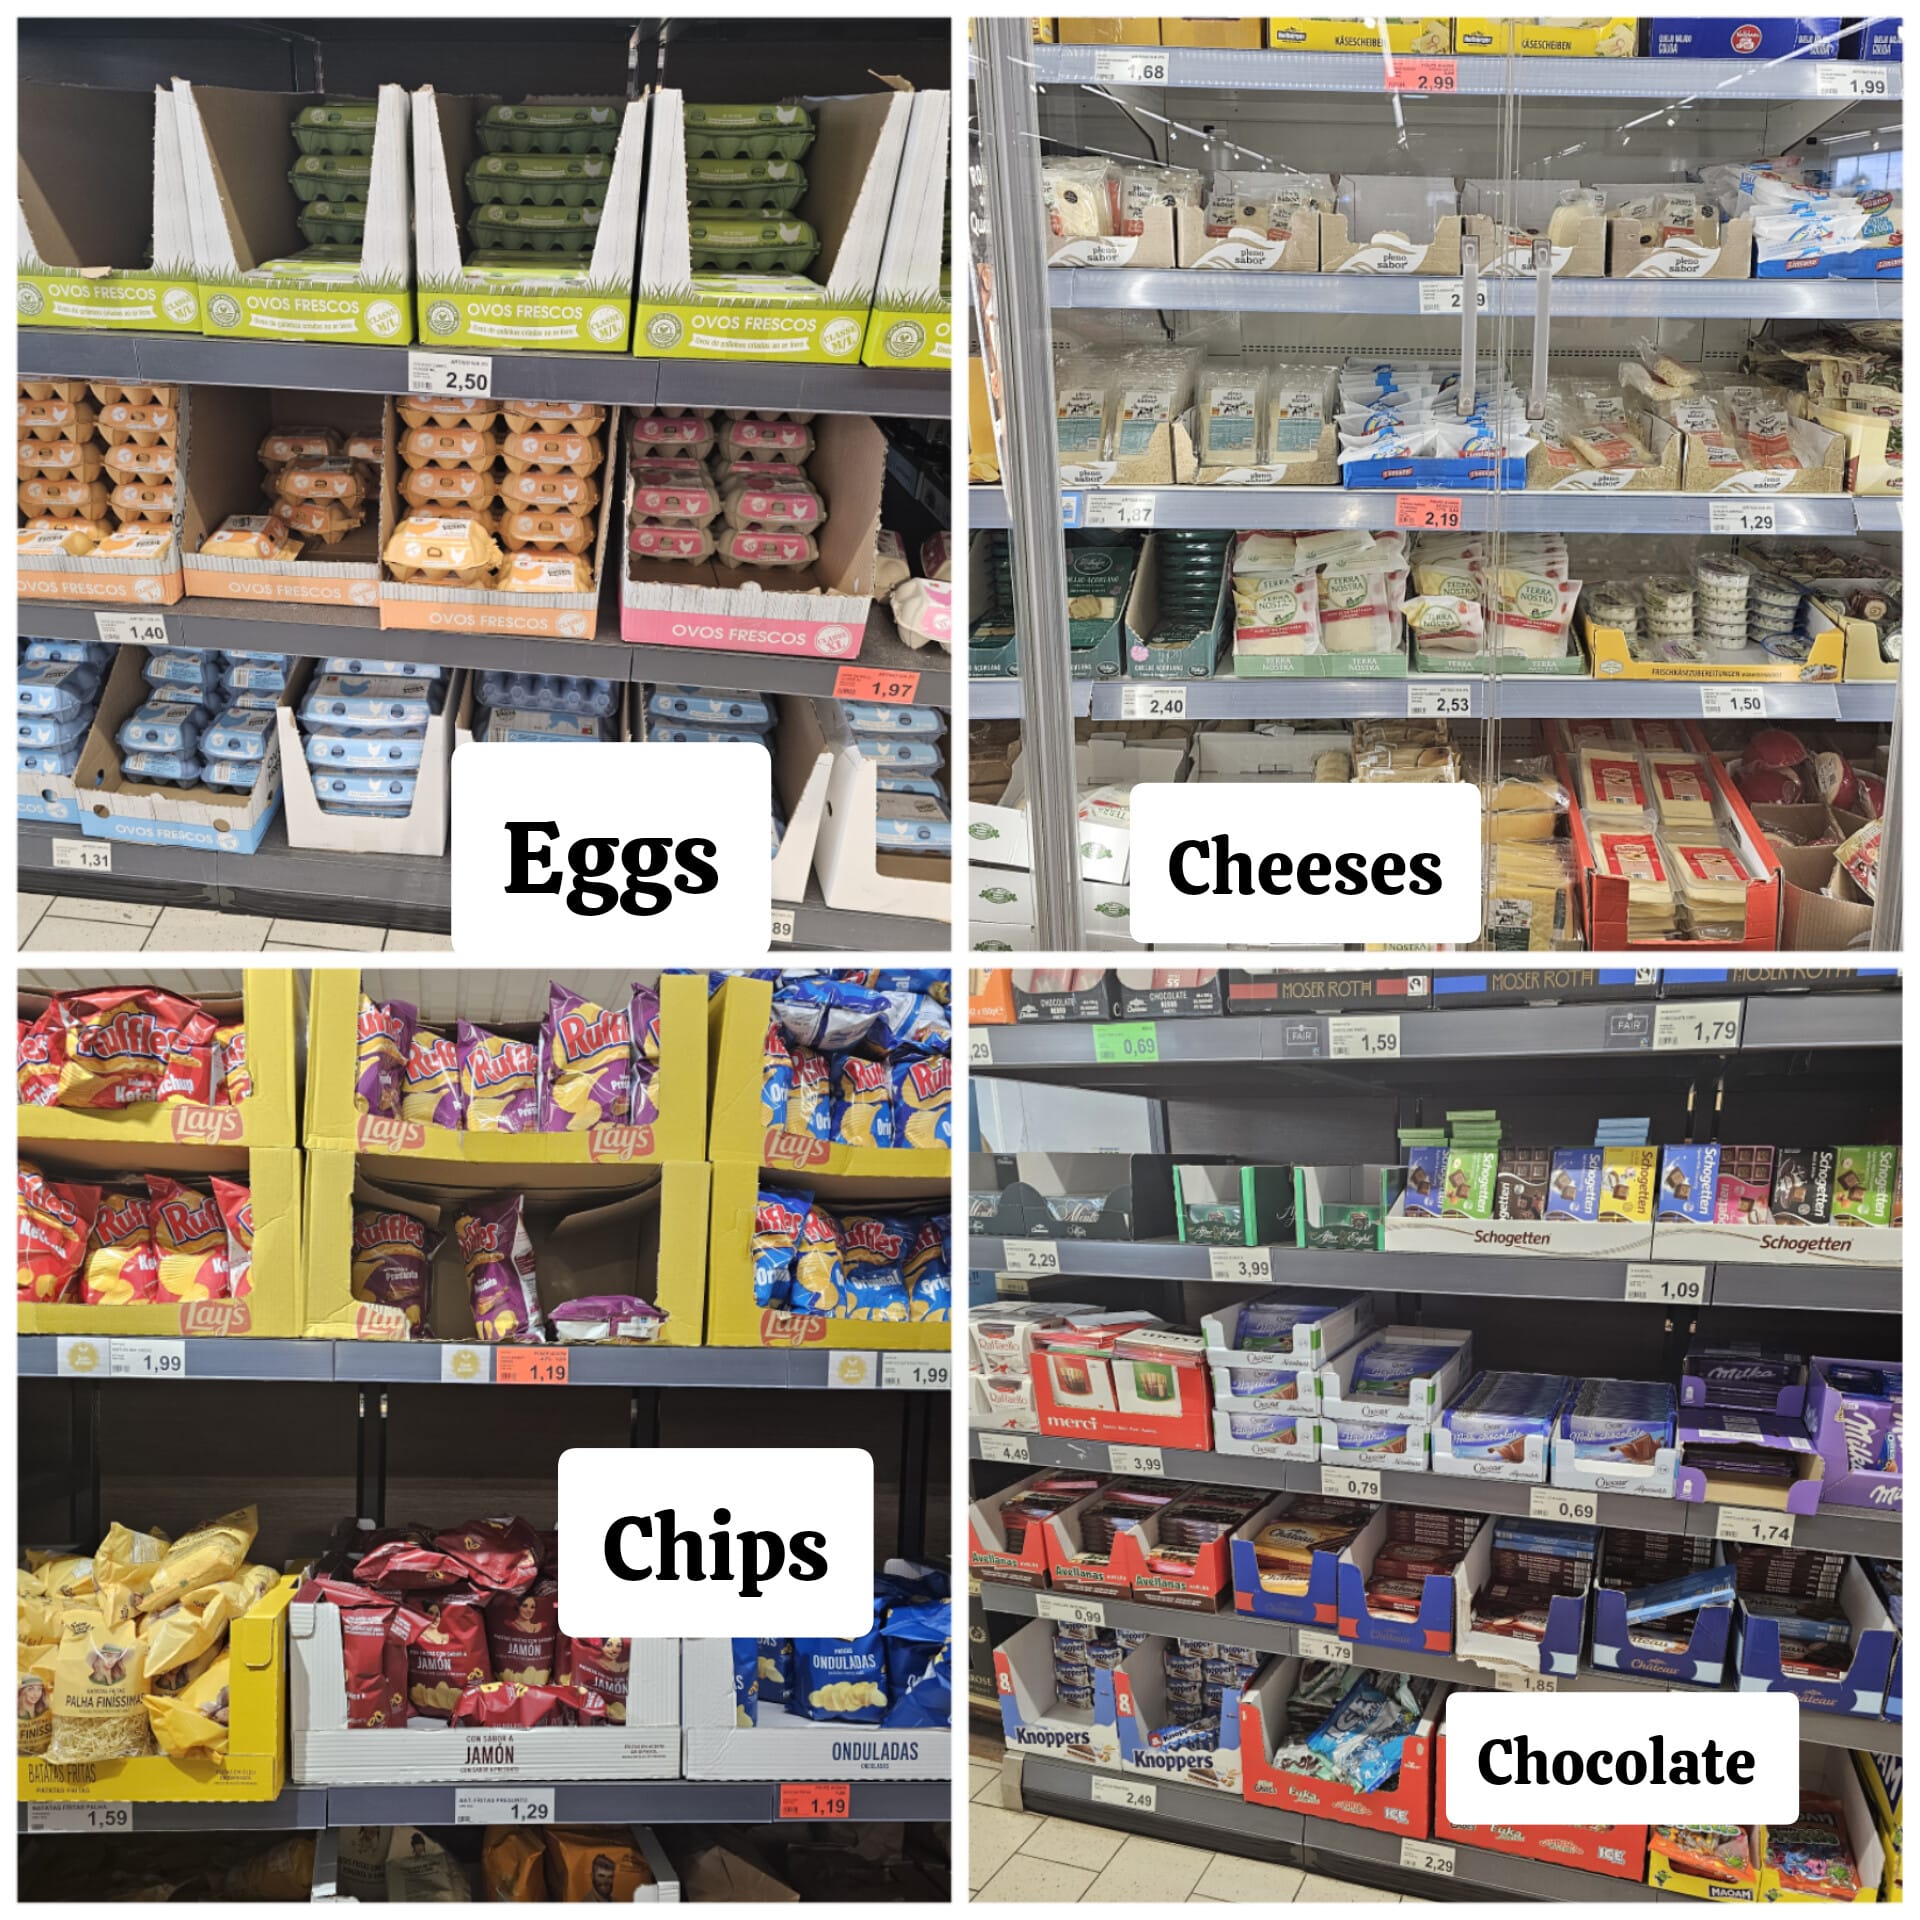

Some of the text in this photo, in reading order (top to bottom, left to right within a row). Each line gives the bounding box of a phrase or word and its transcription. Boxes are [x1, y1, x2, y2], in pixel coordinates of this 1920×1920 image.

[1128, 64, 1164, 80] 1,68
[1418, 76, 1454, 90] 2,99
[1850, 79, 1885, 94] 1,99
[1087, 252, 1118, 262] sabor
[1092, 246, 1117, 255] pleno
[1240, 250, 1264, 258] pleno
[1383, 253, 1407, 262] pleno
[1234, 254, 1266, 264] sabor
[1377, 260, 1408, 270] sabor
[1676, 257, 1700, 266] pleno
[1668, 262, 1700, 273] sabor
[48, 284, 156, 300] OVOS FRESCOS
[246, 296, 360, 314] OVOS FRESCOS
[467, 303, 583, 320] OVOS FRESCOS
[691, 315, 816, 332] OVOS FRESCOS
[446, 372, 488, 390] 2,50
[1118, 508, 1152, 522] 1,87
[1425, 512, 1458, 526] 2,19
[1740, 515, 1773, 530] 1,29
[17, 580, 128, 596] OVOS FRESCOS
[1330, 583, 1364, 592] NOSTRA
[1335, 577, 1361, 585] TERRA
[1446, 582, 1472, 590] TERRA
[228, 582, 342, 599] OVOS FRESCOS
[1443, 587, 1476, 595] NOSTRA
[1526, 588, 1551, 597] TERRA
[1520, 594, 1556, 604] NOSTRA
[430, 612, 548, 630] OVOS FRESCOS
[1423, 620, 1458, 628] NOSTRA
[130, 626, 164, 641] 1,40
[672, 624, 806, 646] OVOS FRESCOS
[1263, 664, 1294, 672] NOSTRA
[1266, 658, 1292, 666] TERRA
[1348, 664, 1380, 672] NOSTRA
[1352, 658, 1377, 666] TERRA
[1448, 660, 1472, 668] TERRA
[872, 682, 912, 698] 1,97
[1150, 700, 1183, 714] 2,40
[1436, 698, 1469, 712] 2,53
[1730, 696, 1760, 712] 1,50
[115, 824, 214, 845] OVOS FRESCOS
[80, 853, 110, 867] 1,31
[1492, 970, 1594, 992] MOSER ROTH
[1733, 969, 1788, 982] MOSER
[1150, 991, 1188, 1001] CHOCOLATE
[1283, 980, 1372, 998] MOSER ROTH
[1040, 998, 1074, 1007] CHOCOLATE
[1618, 1020, 1642, 1031] FAIR
[1694, 1022, 1736, 1042] 1,79
[1292, 1032, 1312, 1040] FAIR
[1361, 1034, 1396, 1052] 1,59
[1124, 1038, 1156, 1054] 0,69
[1477, 1152, 1494, 1213] Schogetten
[1584, 1153, 1600, 1215] Schogetten
[1637, 1152, 1653, 1214] Schogetten
[1700, 1147, 1718, 1215] Schogetten
[1814, 1151, 1832, 1217] Schogetten
[1874, 1152, 1892, 1218] Schogetten
[1474, 1230, 1550, 1247] Schogetten
[1760, 1234, 1852, 1253] Schogetten
[1029, 1252, 1057, 1268] 2,29
[1238, 1260, 1270, 1277] 3,99
[1660, 1282, 1700, 1299] 1,09
[978, 1338, 1020, 1352] Raffaello
[144, 1356, 181, 1374] 1,99
[530, 1365, 566, 1381] 1,19
[1708, 1366, 1776, 1380] Milka
[913, 1368, 948, 1384] 1,99
[1047, 1416, 1098, 1432] merci
[1003, 1448, 1028, 1461] 4,49
[1134, 1458, 1161, 1473] 3,99
[1348, 1480, 1378, 1495] 0,79
[1559, 1502, 1594, 1518] 0,69
[1752, 1524, 1790, 1541] 1,74
[972, 1552, 1017, 1567] Avellanas
[1055, 1564, 1104, 1581] Avellanas
[1135, 1575, 1186, 1591] Avellanas
[1074, 1609, 1101, 1623] 0,99
[508, 1642, 542, 1657] JAMÓN
[1322, 1646, 1351, 1660] 1,79
[417, 1654, 452, 1671] JAMÓN
[812, 1654, 876, 1670] ONDULADAS
[1632, 1658, 1680, 1675] Château
[594, 1676, 629, 1696] JAMÓN
[1524, 1678, 1554, 1692] 1,85
[66, 1695, 94, 1707] PALHA
[1015, 1727, 1090, 1746] Knoppers
[464, 1743, 514, 1765] JAMÓN
[832, 1742, 918, 1761] ONDULADAS
[1134, 1749, 1214, 1771] Knoppers
[28, 1764, 96, 1783] BATATAS FRITAS
[812, 1799, 846, 1815] 1,19
[1128, 1792, 1152, 1807] 2,49
[88, 1810, 128, 1828] 1,59
[511, 1804, 548, 1820] 1,29
[1384, 1808, 1409, 1821] ICE
[1598, 1846, 1626, 1861] ICE
[1425, 1856, 1453, 1873] 2,29
[1710, 1886, 1753, 1900] MAOAM
